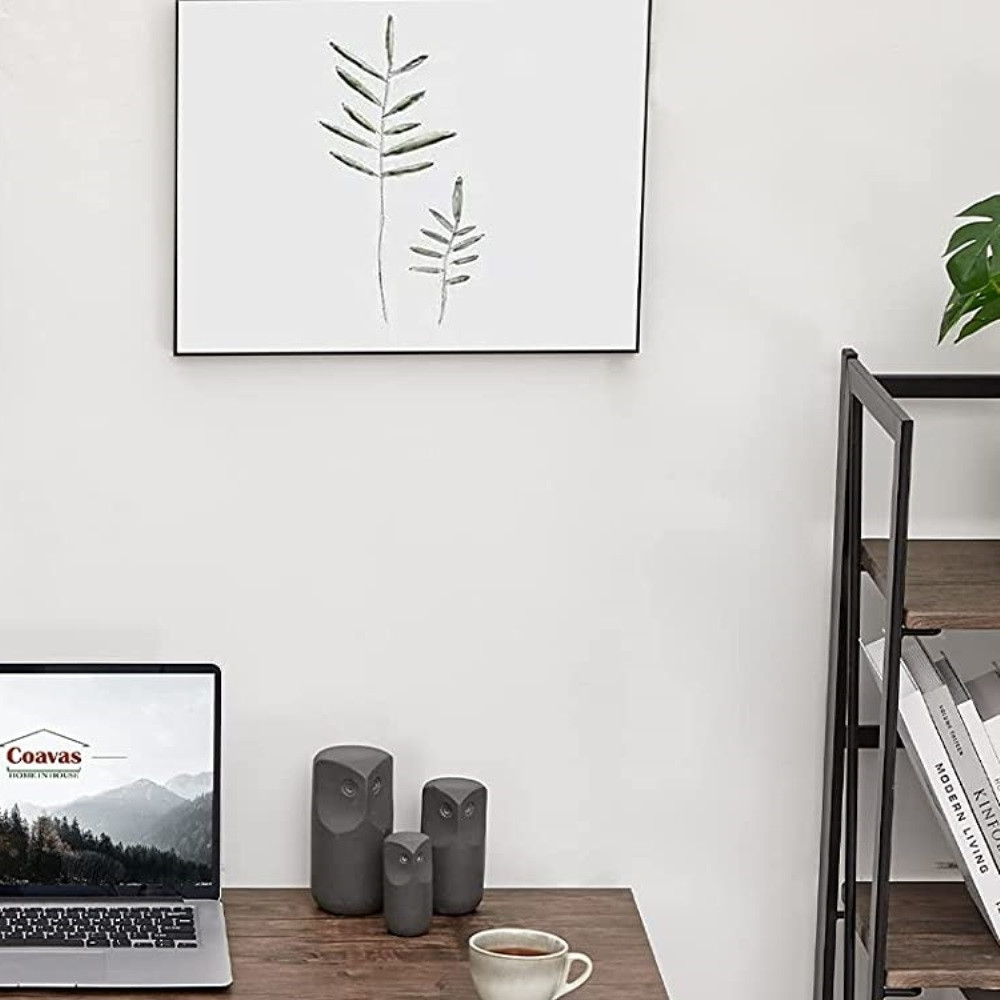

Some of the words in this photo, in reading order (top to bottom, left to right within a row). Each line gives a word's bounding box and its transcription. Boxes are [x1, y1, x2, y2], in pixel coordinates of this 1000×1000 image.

[6, 746, 82, 764] Coavas
[935, 762, 966, 822] MODERN
[962, 826, 989, 874] LIVING
[973, 788, 1000, 852] KINFO
